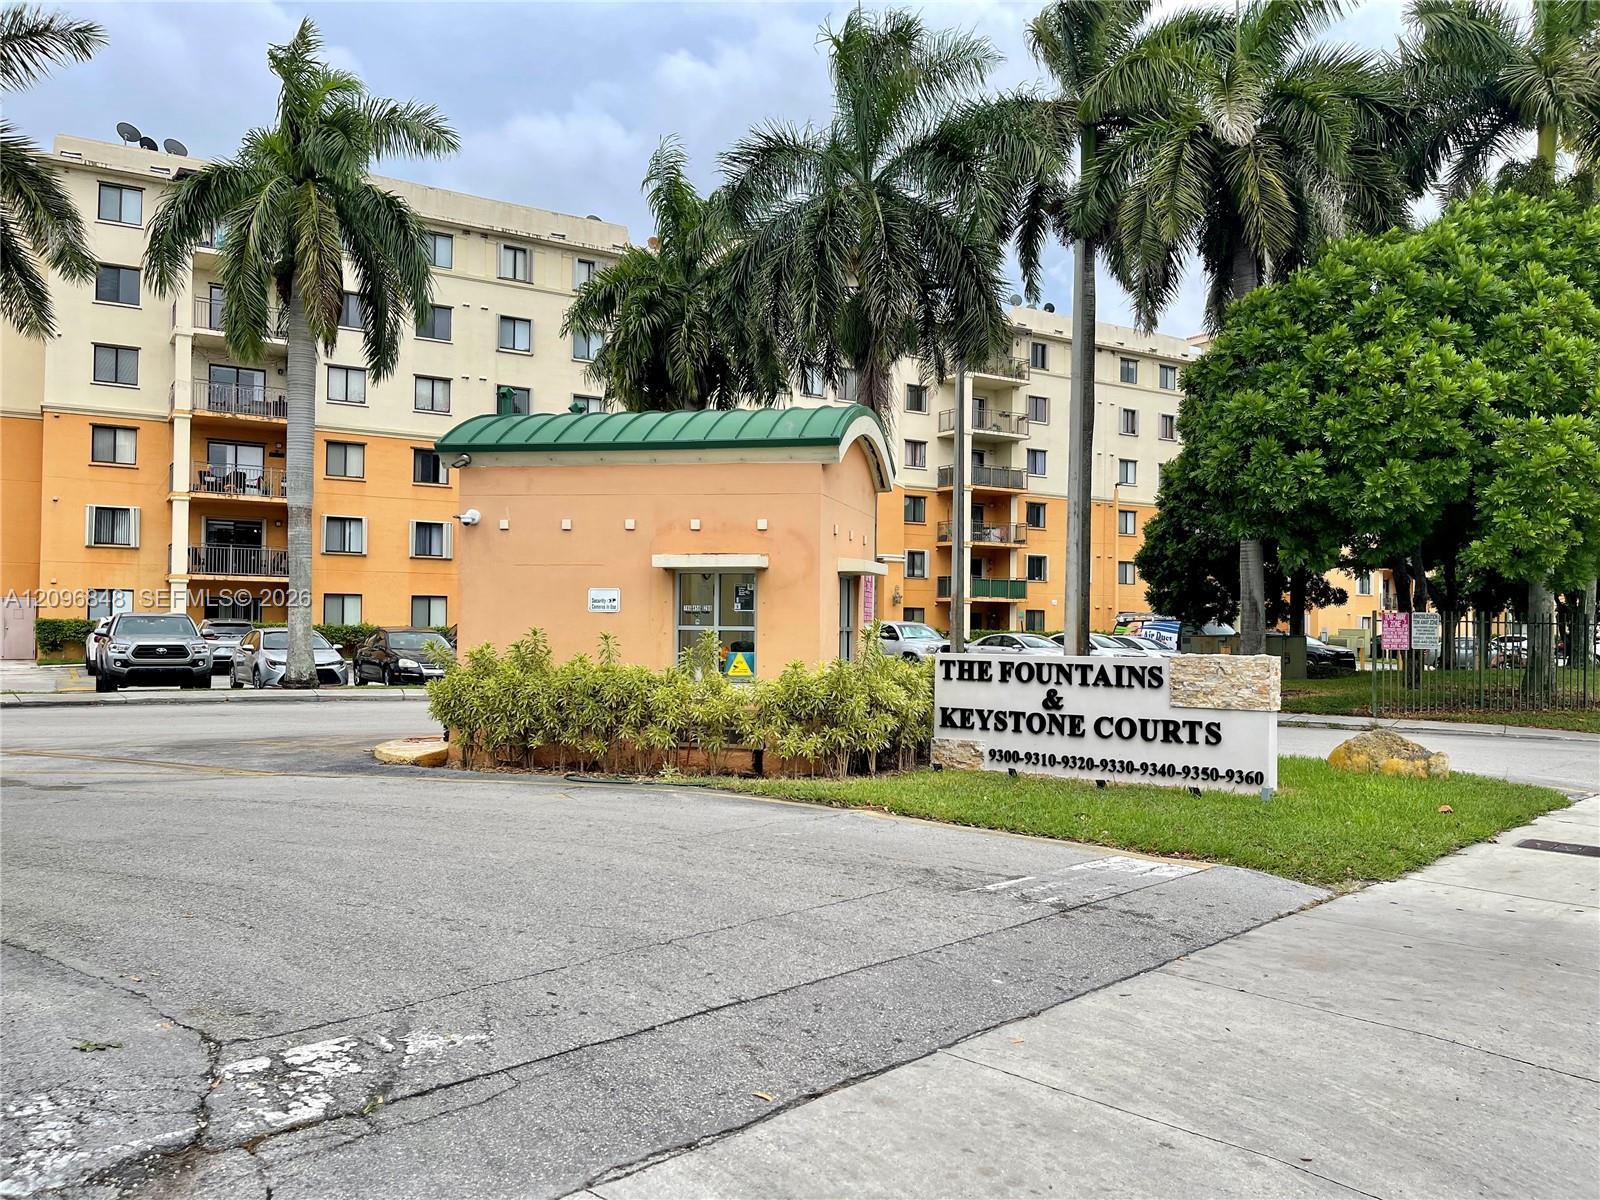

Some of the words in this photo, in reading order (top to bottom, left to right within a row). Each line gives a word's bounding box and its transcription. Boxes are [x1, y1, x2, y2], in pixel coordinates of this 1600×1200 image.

[1144, 631, 1155, 639] Air
[939, 659, 993, 682] THE
[998, 661, 1164, 689] FOUNTAINS
[1041, 688, 1064, 711] &
[939, 706, 1086, 738] KEYSTONE
[1093, 716, 1223, 746] COURTS
[988, 748, 1265, 786] 9300-9310-9320-9330-9340-9350-9360
